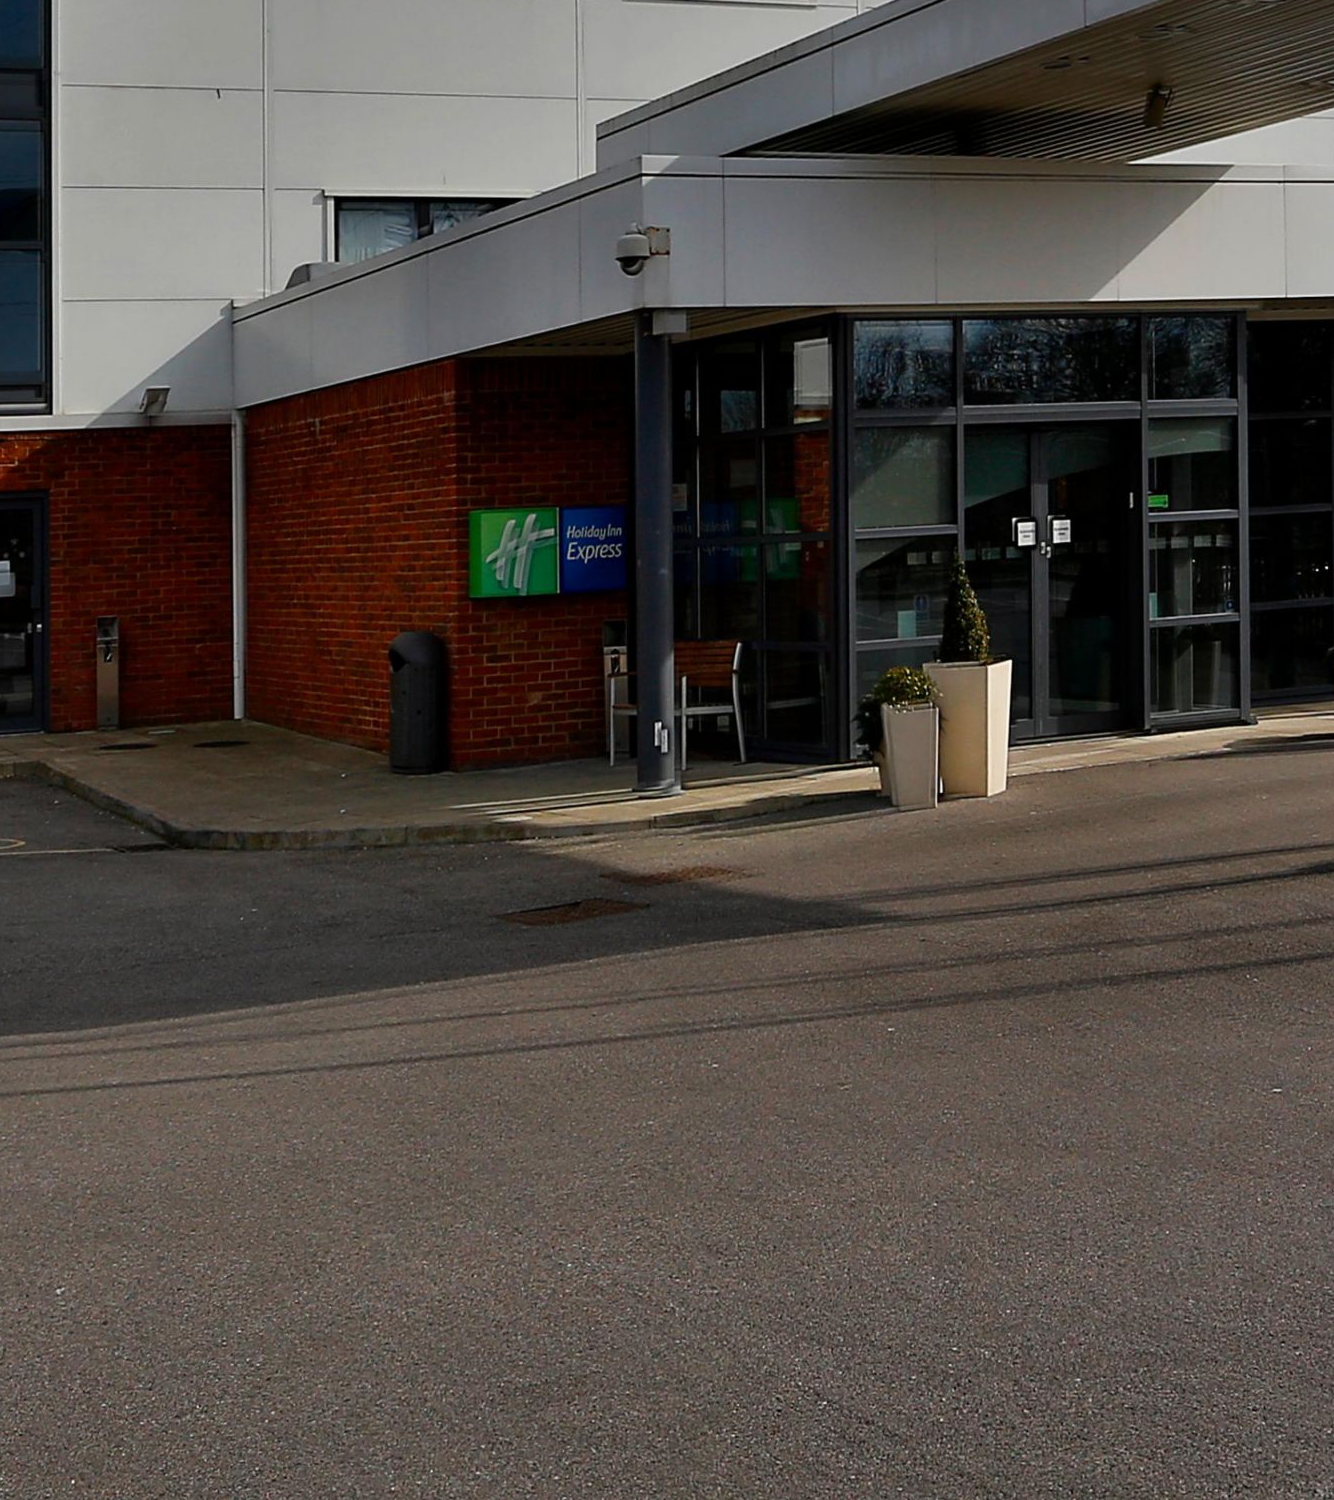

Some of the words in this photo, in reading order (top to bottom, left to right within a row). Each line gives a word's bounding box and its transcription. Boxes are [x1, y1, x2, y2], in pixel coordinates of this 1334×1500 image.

[567, 525, 606, 540] Holiday
[607, 523, 622, 537] Inn
[567, 541, 623, 564] Express
